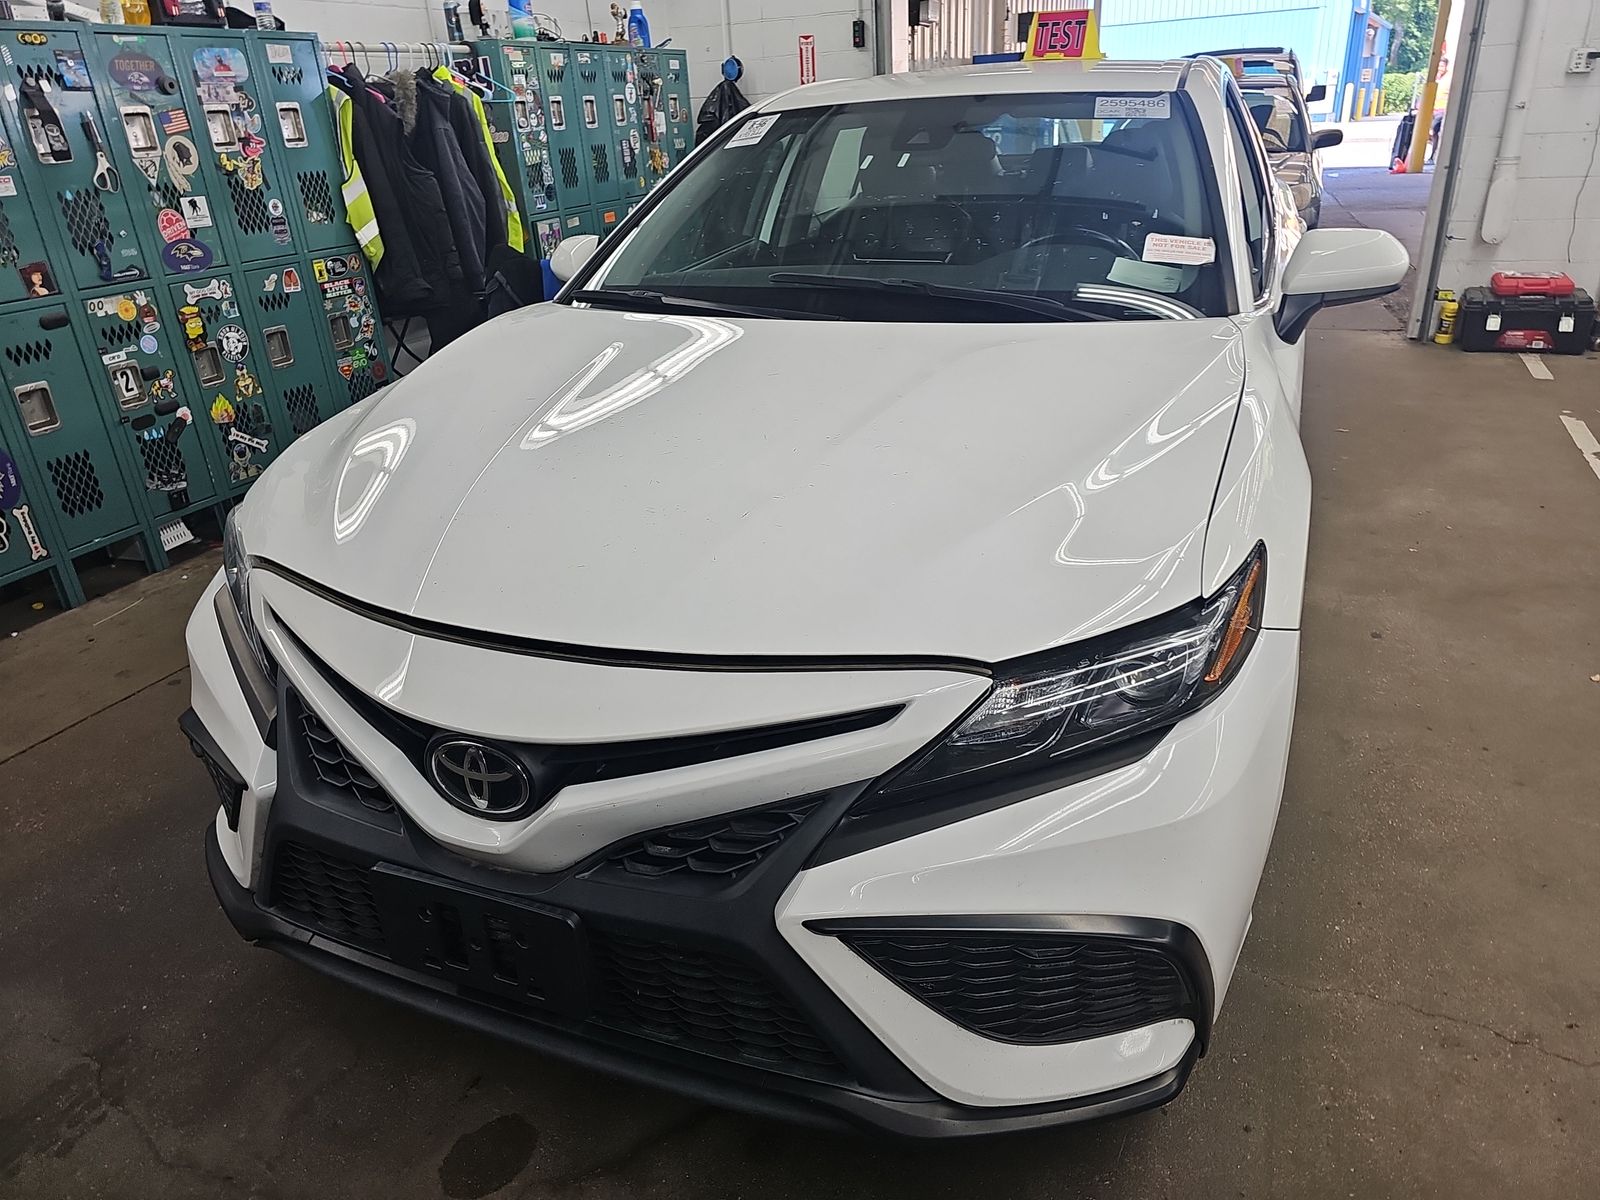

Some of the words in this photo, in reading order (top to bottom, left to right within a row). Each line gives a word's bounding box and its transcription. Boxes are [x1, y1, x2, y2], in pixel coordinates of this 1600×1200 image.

[1037, 19, 1087, 50] TEST
[114, 59, 155, 72] TOGETHER
[1099, 99, 1166, 108] 2595486
[162, 220, 187, 238] DRIVEN
[1170, 238, 1201, 246] VEHICLE
[324, 279, 350, 289] BLACK
[326, 289, 352, 298] MATTER
[327, 285, 349, 293] LIVES
